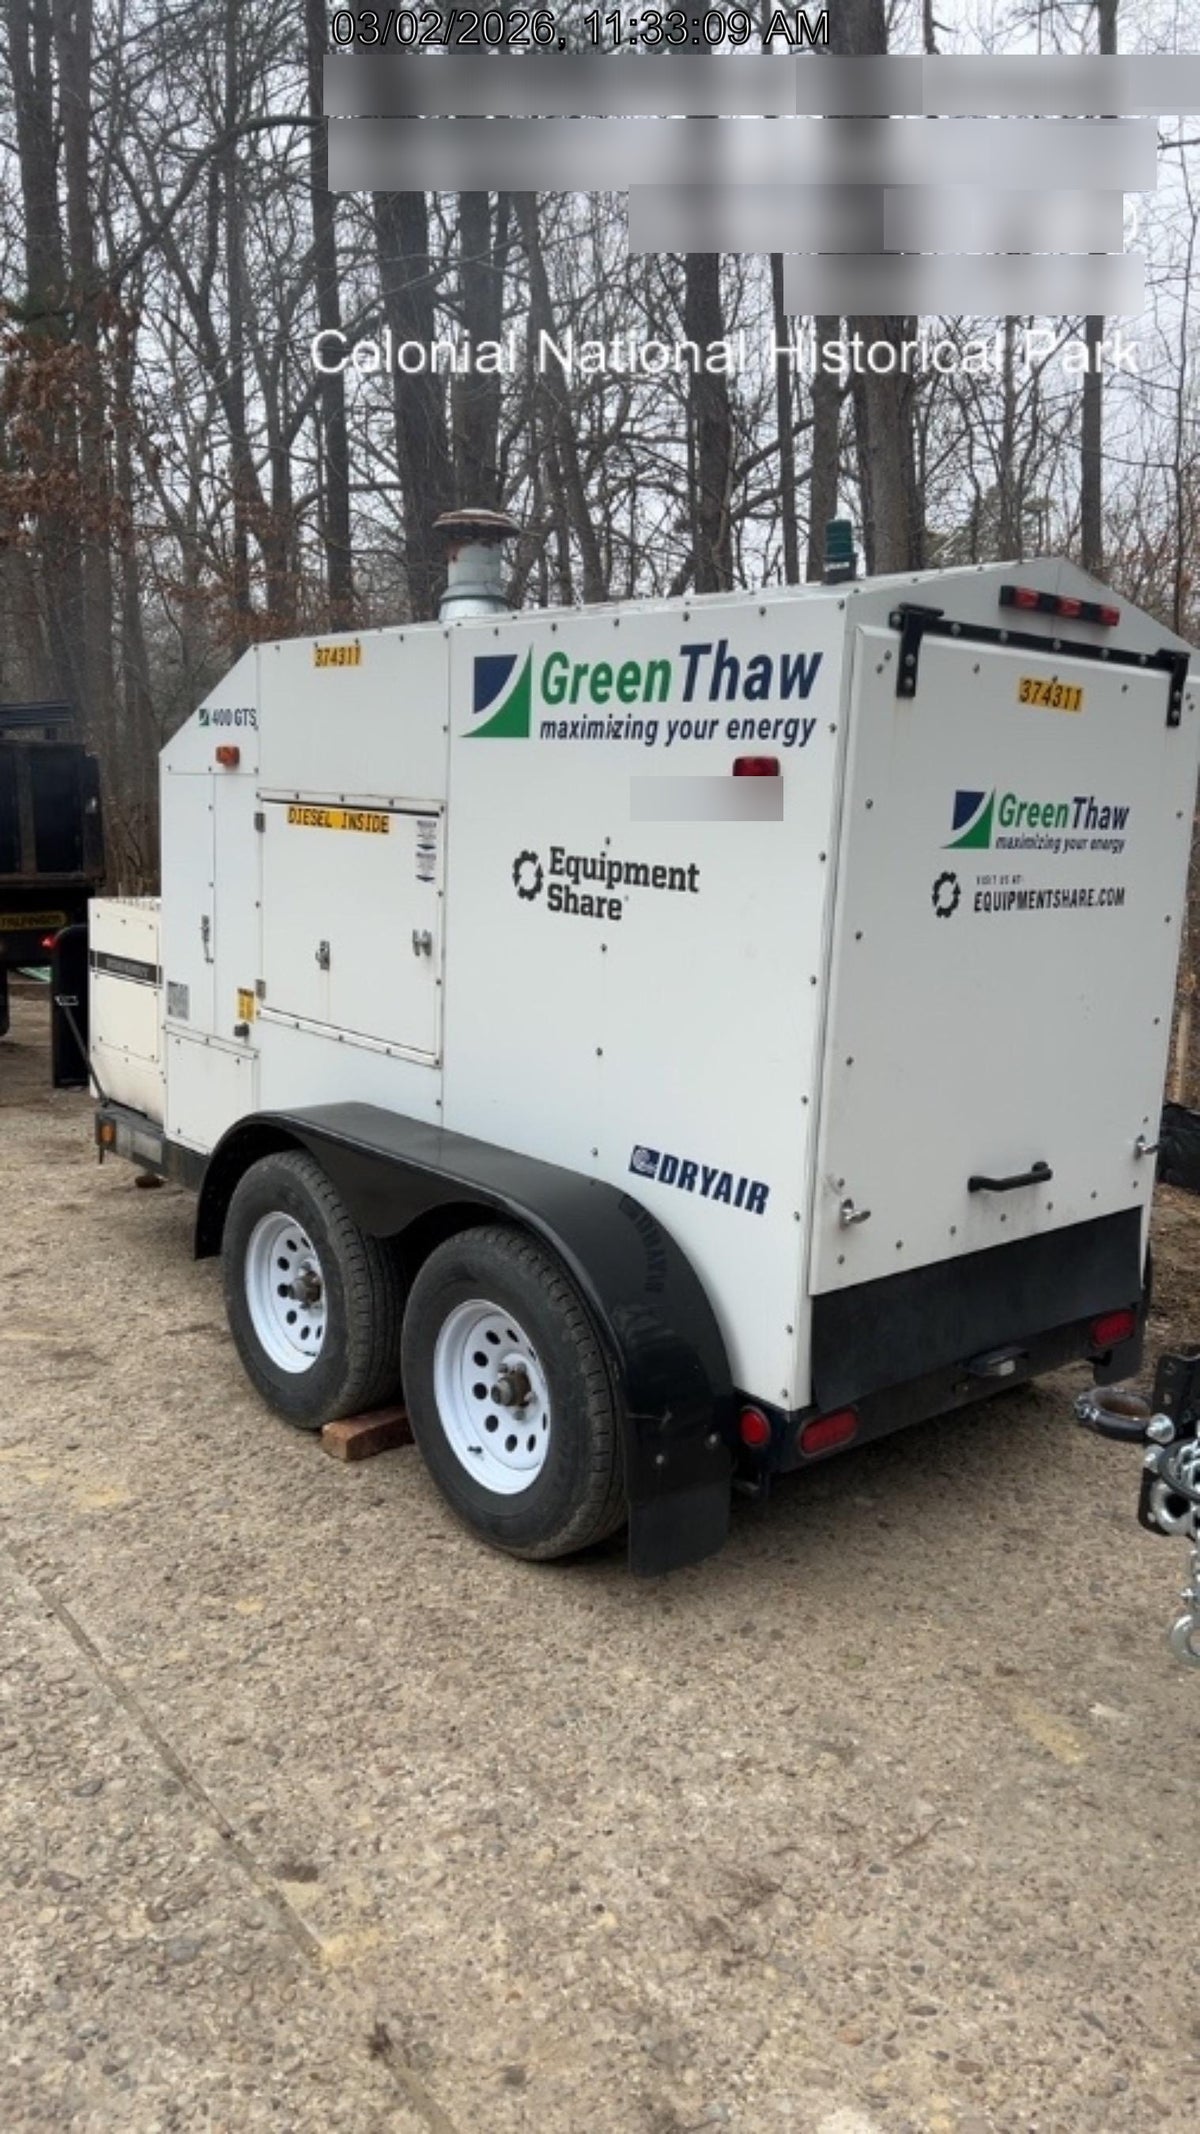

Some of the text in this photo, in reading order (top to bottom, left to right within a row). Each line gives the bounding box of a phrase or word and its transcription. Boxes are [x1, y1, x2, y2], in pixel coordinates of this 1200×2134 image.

[314, 645, 361, 667] 374311
[1019, 679, 1083, 711] 374311
[213, 708, 257, 728] 400 GTS
[540, 714, 817, 747] maximizing your energy
[287, 806, 332, 828] DIESEL
[340, 813, 390, 834] INSIDE
[995, 833, 1126, 854] maximizing your energy
[549, 846, 700, 893] Equipment
[547, 883, 622, 921] Share
[974, 887, 1126, 913] EQUIPMENTSHARE.COM
[657, 1153, 770, 1215] DRYAIR
